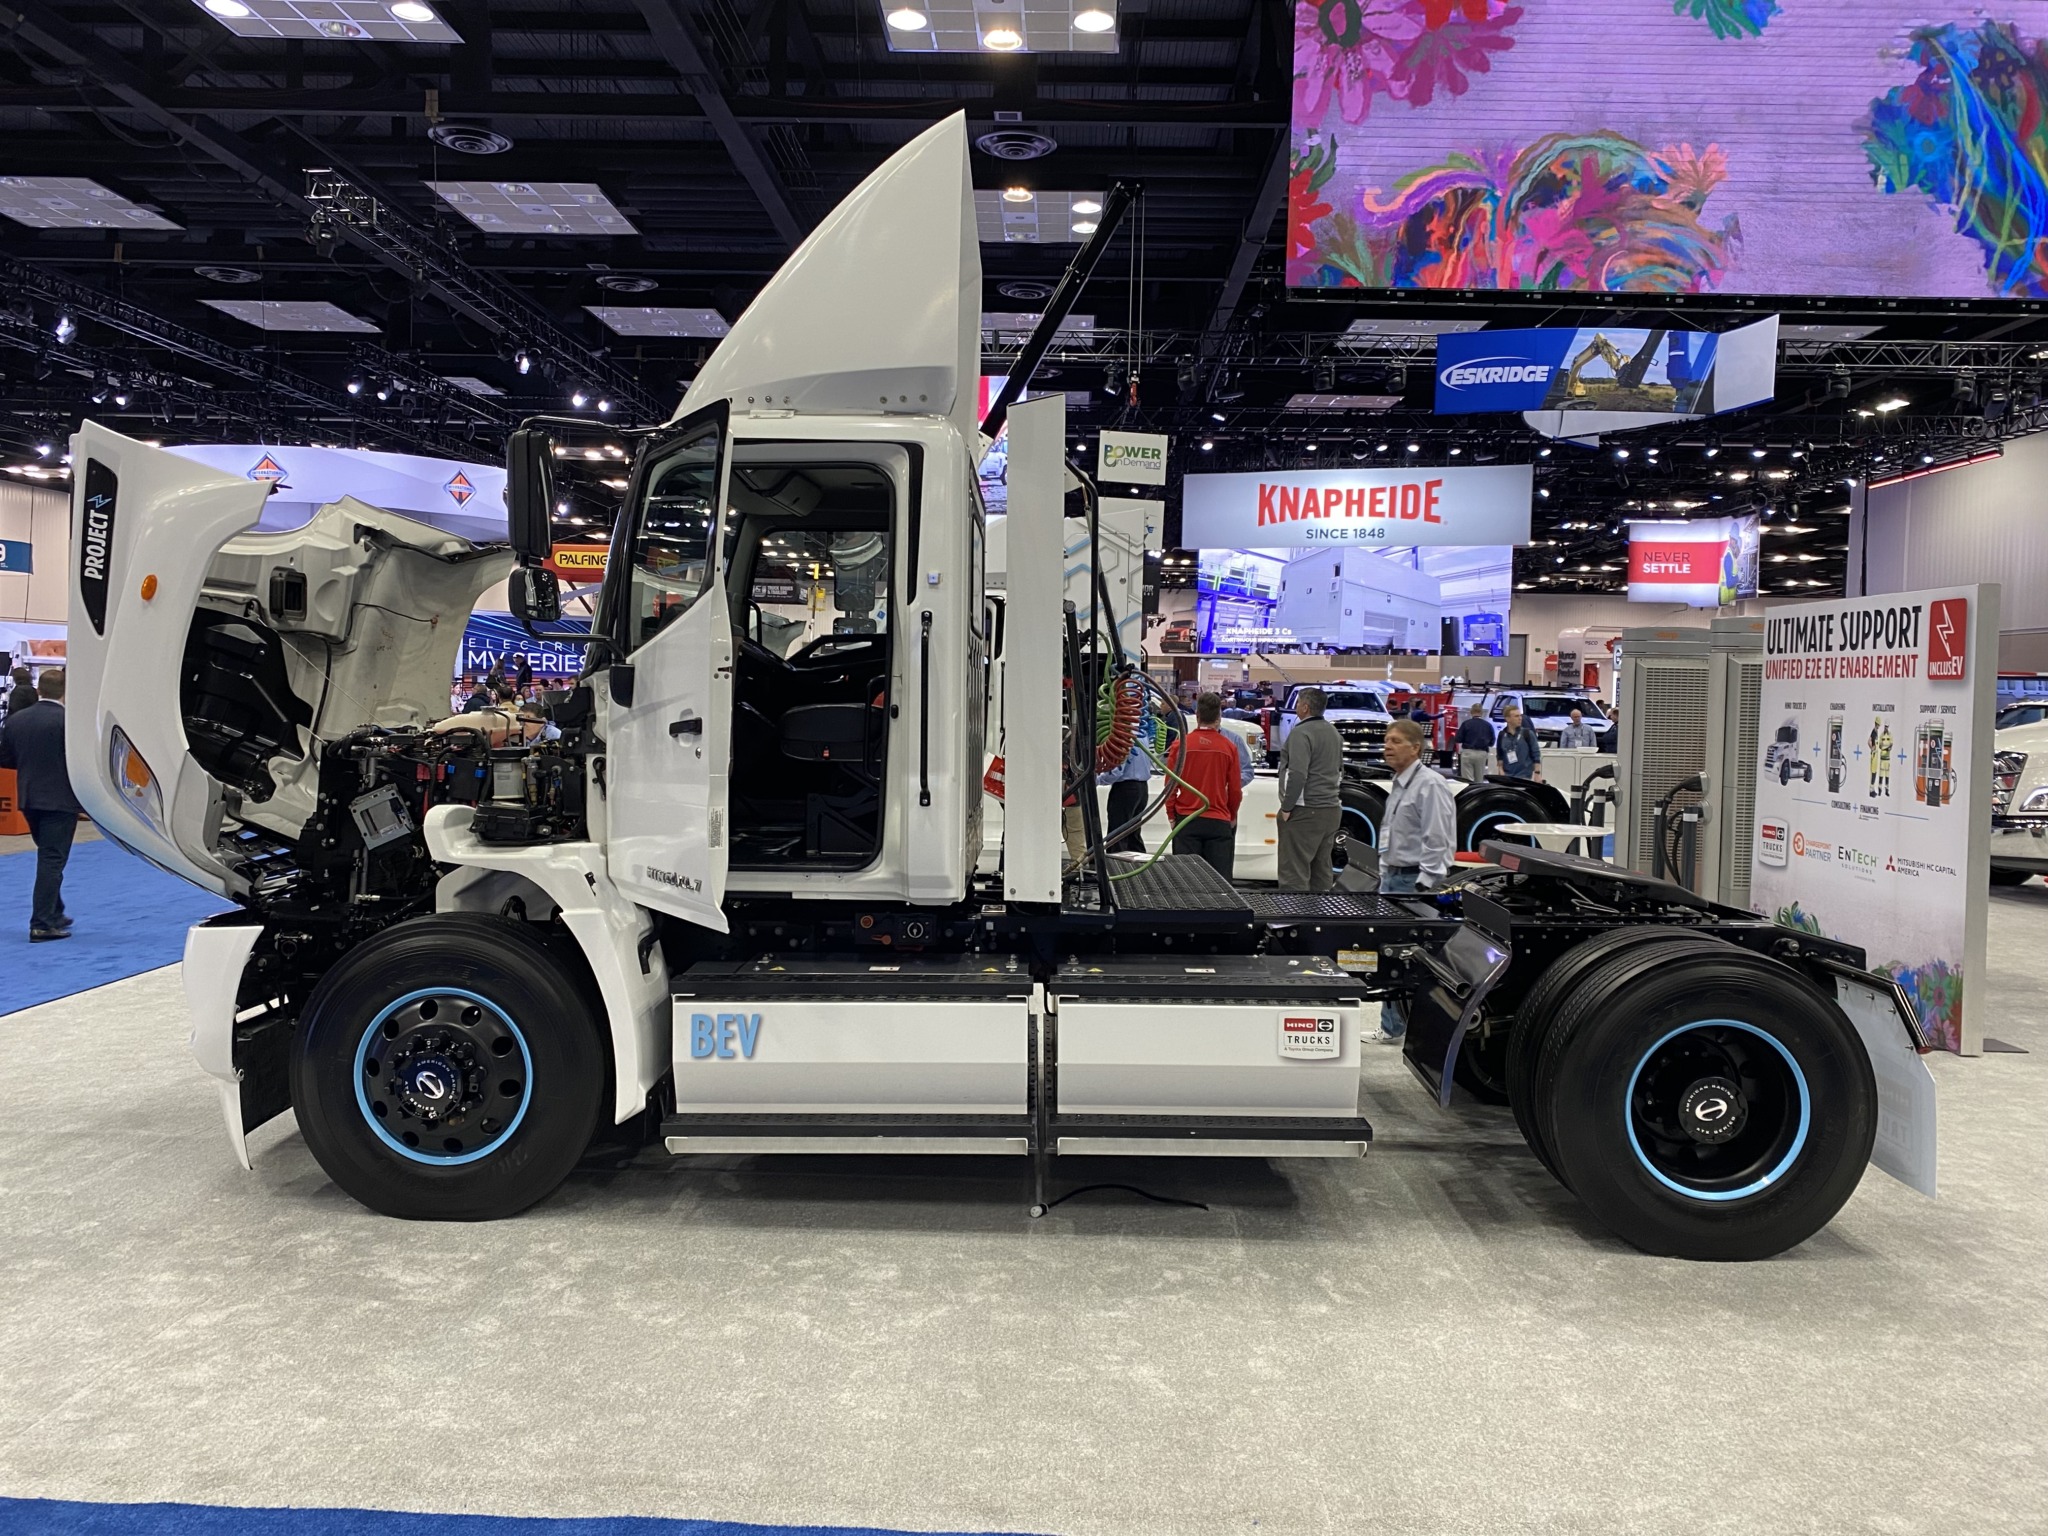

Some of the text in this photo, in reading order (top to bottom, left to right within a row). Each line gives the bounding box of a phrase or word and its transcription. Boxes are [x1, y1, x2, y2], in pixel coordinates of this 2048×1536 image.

[1450, 366, 1549, 385] ESKRIDGE
[1104, 444, 1161, 460] POWER
[1123, 458, 1161, 468] Demand
[1258, 479, 1443, 527] KNAPHEIDE
[1306, 528, 1385, 539] SINCE 1848
[84, 509, 108, 580] PROJECT
[1643, 552, 1690, 562] NEVER
[1642, 563, 1691, 573] SETTLE
[1226, 627, 1273, 635] KNAPHEIDE
[1767, 605, 1922, 655] ULTIMATE SUPPORT
[1765, 654, 1918, 680] UNIFIED E2E EV ENABLEMENT
[1872, 703, 1895, 712] INSTALLATION
[1919, 704, 1937, 714] SUPPORT
[1940, 705, 1957, 714] SERVICE
[1763, 841, 1783, 853] TRUCKS
[1805, 848, 1832, 862] PARTNER
[1841, 863, 1873, 875] SOLUTIONS
[1897, 858, 1957, 876] MITSUBISHI HC CAPITAL
[1897, 867, 1919, 877] AMERICA
[691, 1014, 761, 1058] BEV
[1287, 1036, 1330, 1045] TRUCKS
